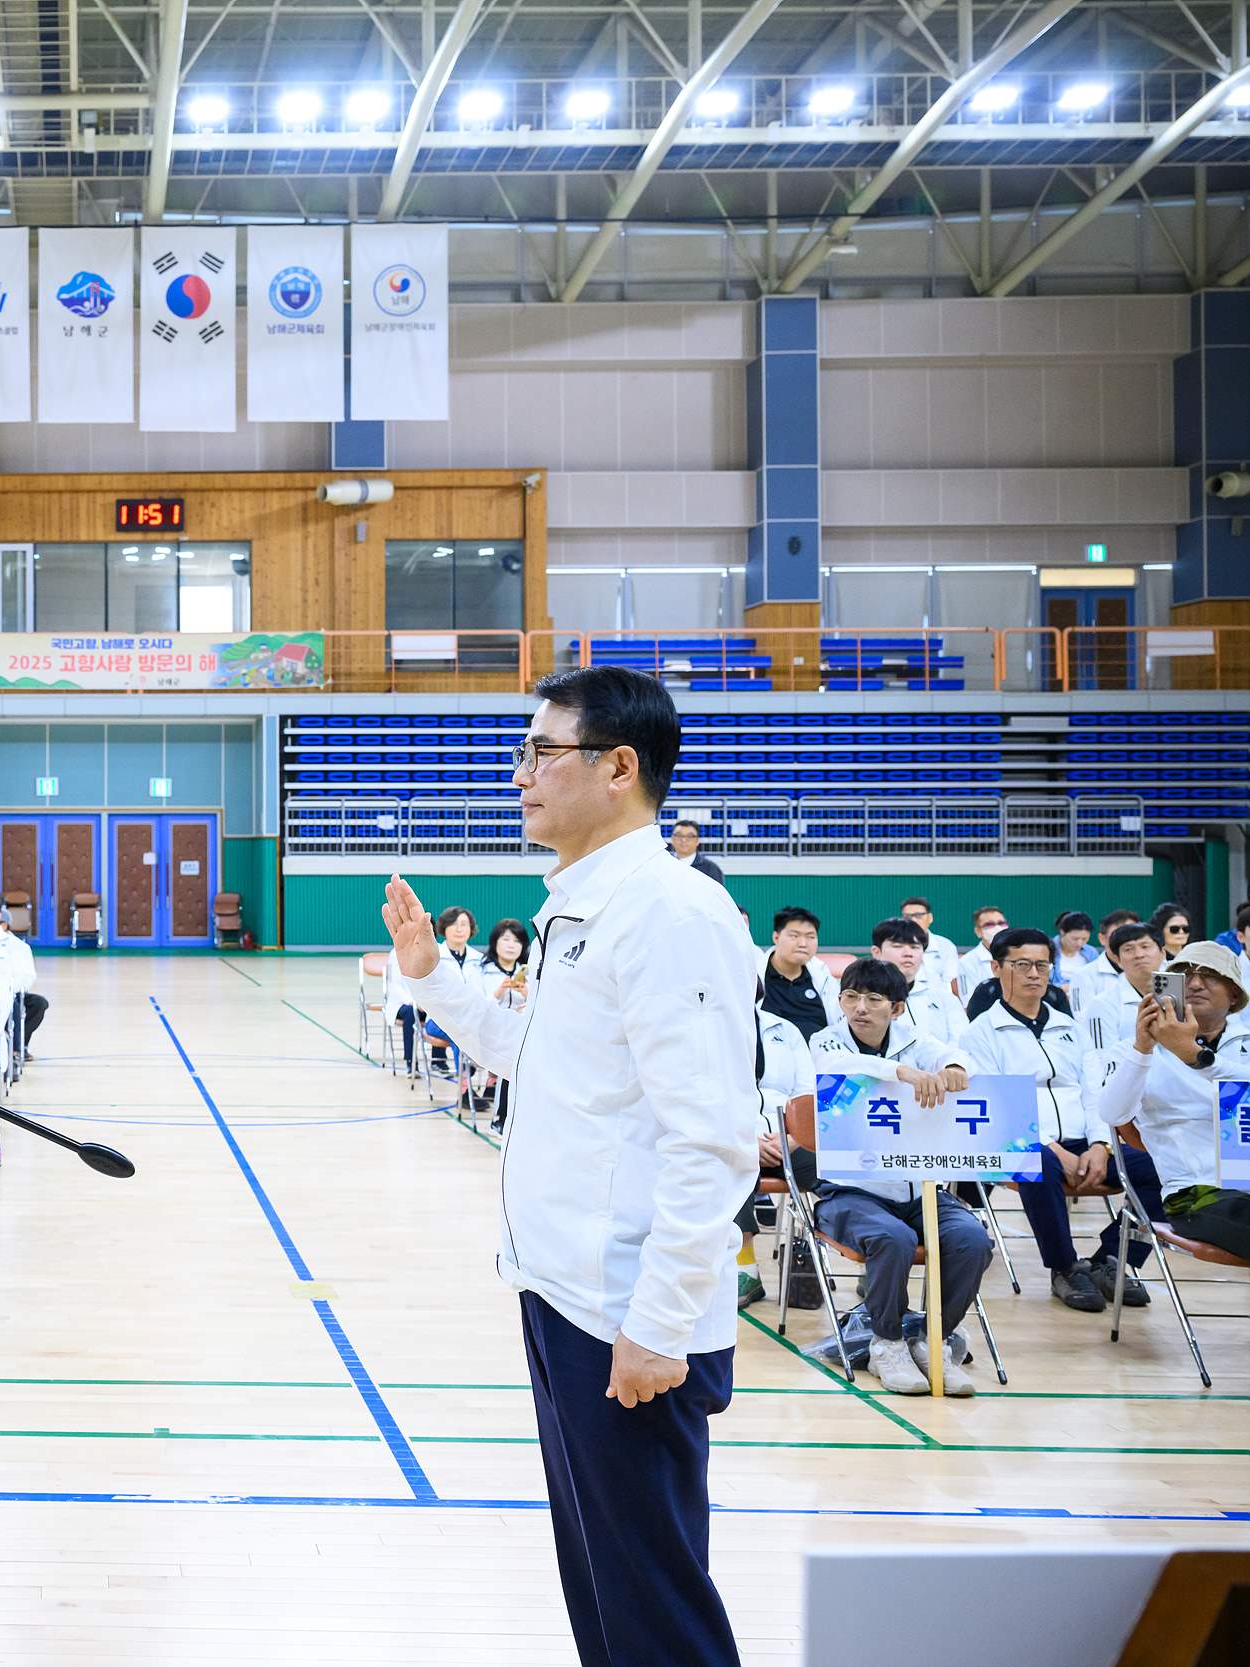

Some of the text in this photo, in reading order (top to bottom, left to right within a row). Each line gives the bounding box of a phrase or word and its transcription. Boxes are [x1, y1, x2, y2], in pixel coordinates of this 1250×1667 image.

[121, 503, 180, 525] 11:51
[101, 638, 135, 649] 남해로
[138, 638, 173, 649] 오시다
[8, 655, 52, 670] 2025
[59, 654, 132, 672] 고향사랑
[137, 655, 192, 672] 방문의
[198, 653, 216, 672] 해
[881, 1154, 1002, 1169] 남해군장애인체육회
